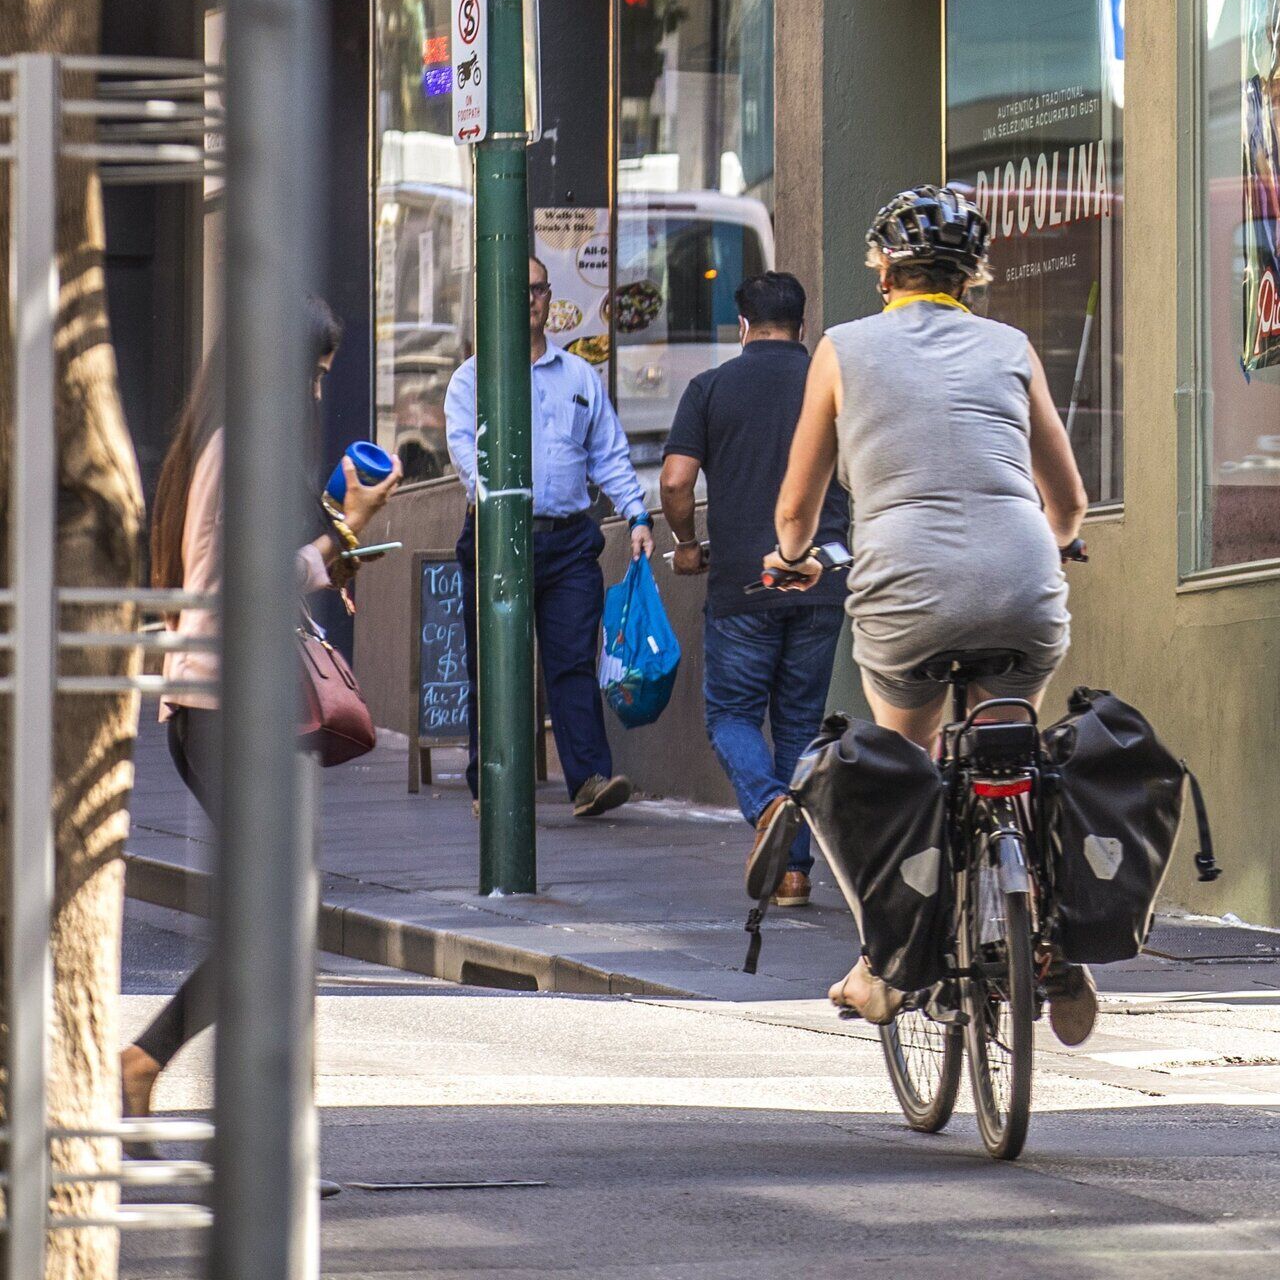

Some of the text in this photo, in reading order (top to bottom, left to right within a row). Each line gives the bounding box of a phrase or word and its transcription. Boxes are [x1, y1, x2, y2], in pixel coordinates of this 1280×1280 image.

[982, 98, 1100, 141] UNA SELEZIONE ACCURATA DI GUSTI
[997, 97, 1034, 120] AUTHENTIC
[1041, 85, 1085, 106] TRADITIONAL
[975, 139, 1111, 242] PICCOLINA
[1005, 253, 1077, 282] GELATERIA NATURALE
